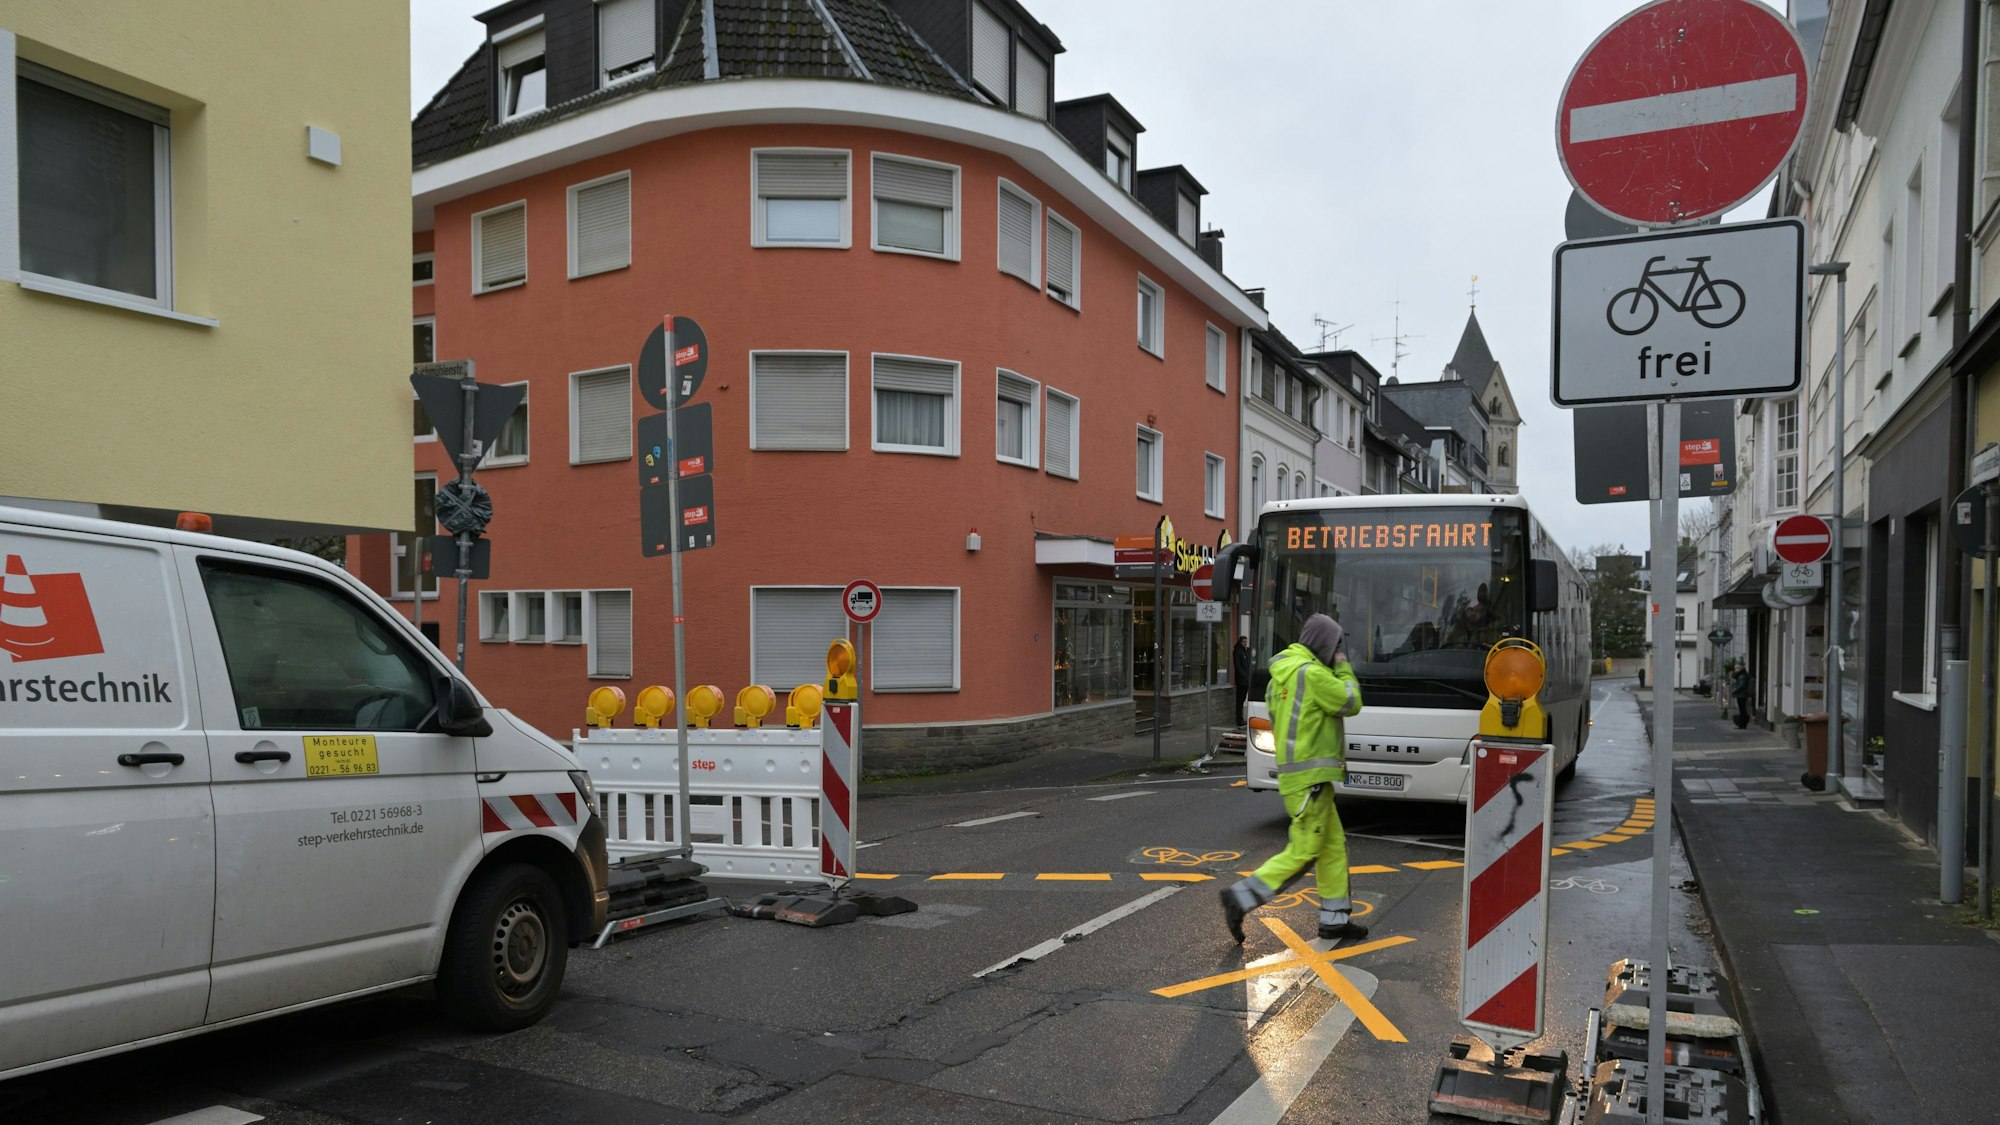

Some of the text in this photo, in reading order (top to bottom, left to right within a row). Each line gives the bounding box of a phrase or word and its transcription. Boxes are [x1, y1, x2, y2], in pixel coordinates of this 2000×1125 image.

[1637, 341, 1711, 379] frei
[1287, 523, 1493, 549] BETRIEBSFAHRT
[0, 672, 172, 703] rstechnik
[313, 737, 367, 747] Monteure
[1349, 743, 1420, 754] ETRA
[319, 747, 365, 760] gesucht
[309, 765, 329, 775] 0221
[339, 764, 350, 773] 56
[353, 763, 363, 773] 96
[366, 762, 376, 772] 83
[692, 759, 716, 771] step
[1350, 775, 1402, 788] NR EB 800
[380, 804, 423, 819] 56968-3
[297, 821, 424, 848] step-verkehrstechnik.de
[1618, 1034, 1647, 1046] step
[1704, 1048, 1733, 1060] step
